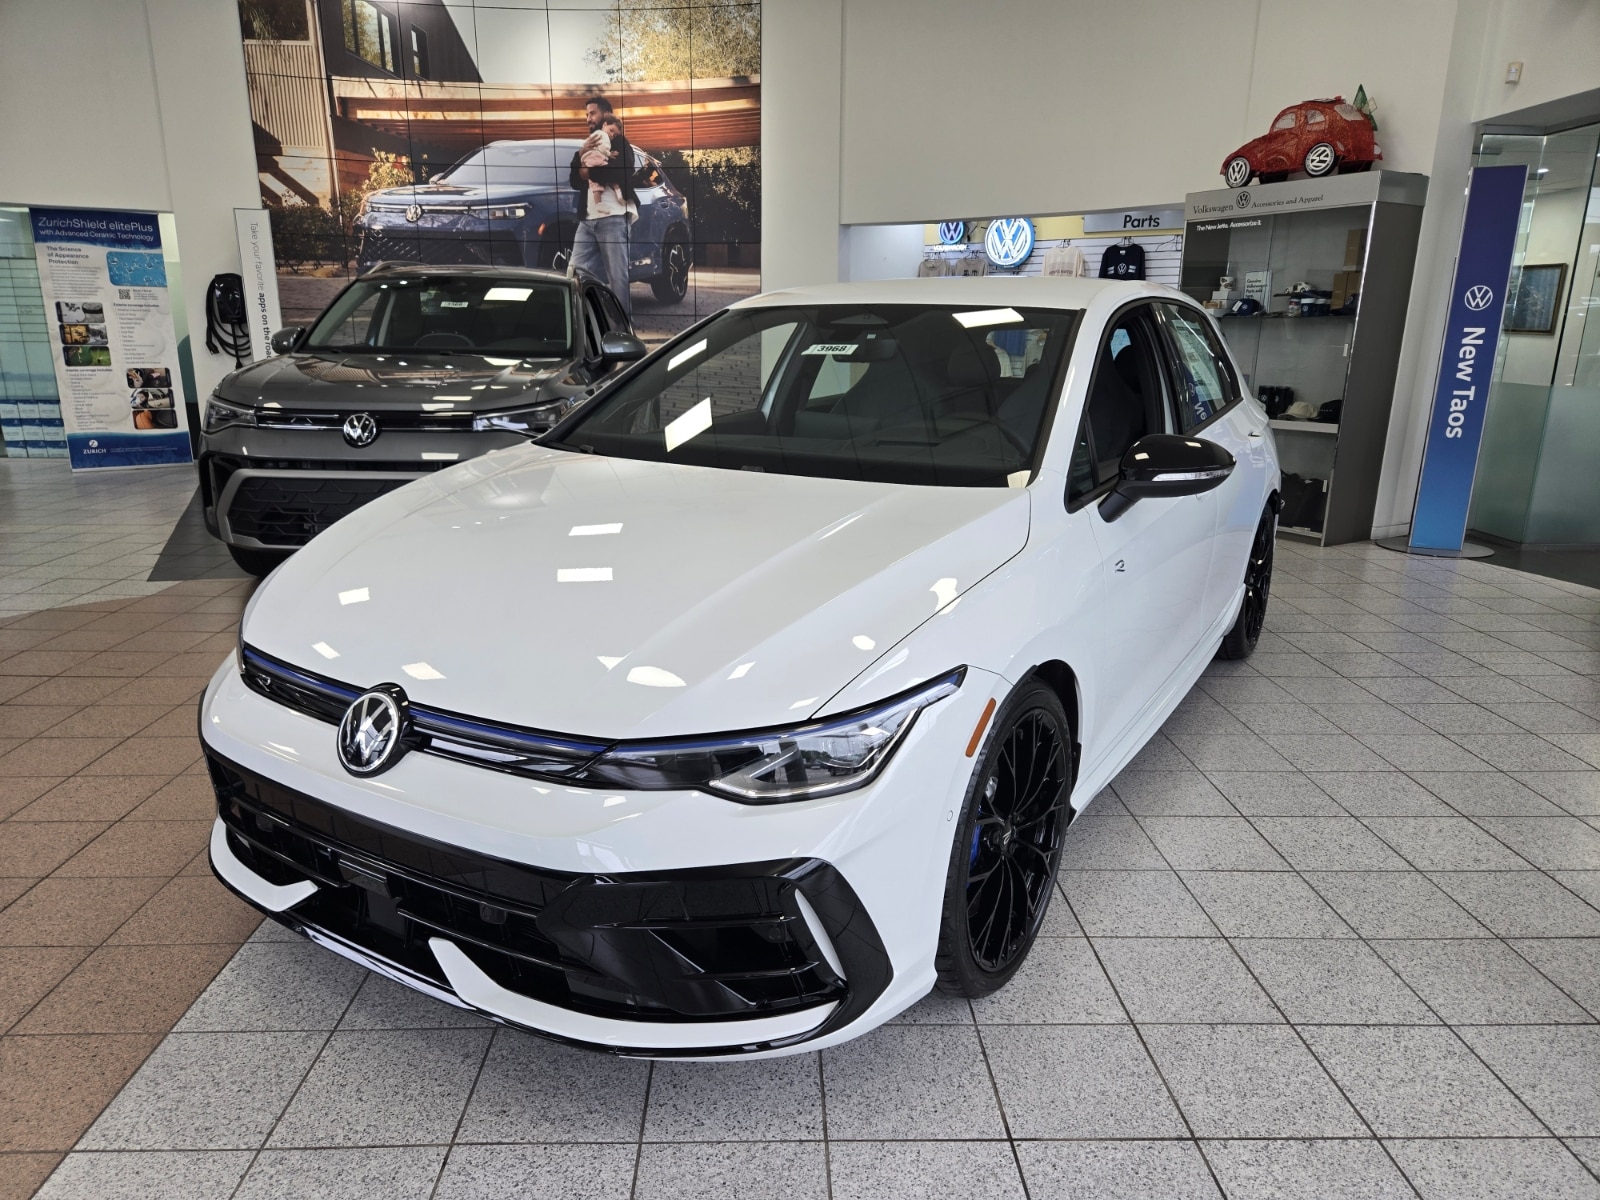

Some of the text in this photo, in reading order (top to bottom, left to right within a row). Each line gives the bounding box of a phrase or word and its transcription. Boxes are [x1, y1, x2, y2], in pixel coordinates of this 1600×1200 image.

[1193, 194, 1324, 214] Volkswagen Accessories and Apparel
[38, 217, 154, 232] ZurichShield elitePlus
[250, 222, 259, 239] Take
[1123, 214, 1160, 229] Parts
[55, 229, 89, 237] Advanced
[89, 231, 116, 239] Ceramic
[117, 232, 154, 242] Technology
[250, 241, 261, 260] your
[255, 261, 265, 291] favorite
[258, 292, 267, 313] apps
[1464, 284, 1494, 311] VW
[261, 314, 268, 326] on
[263, 327, 271, 341] the
[1445, 327, 1486, 439] New Taos
[338, 691, 399, 773] VW
